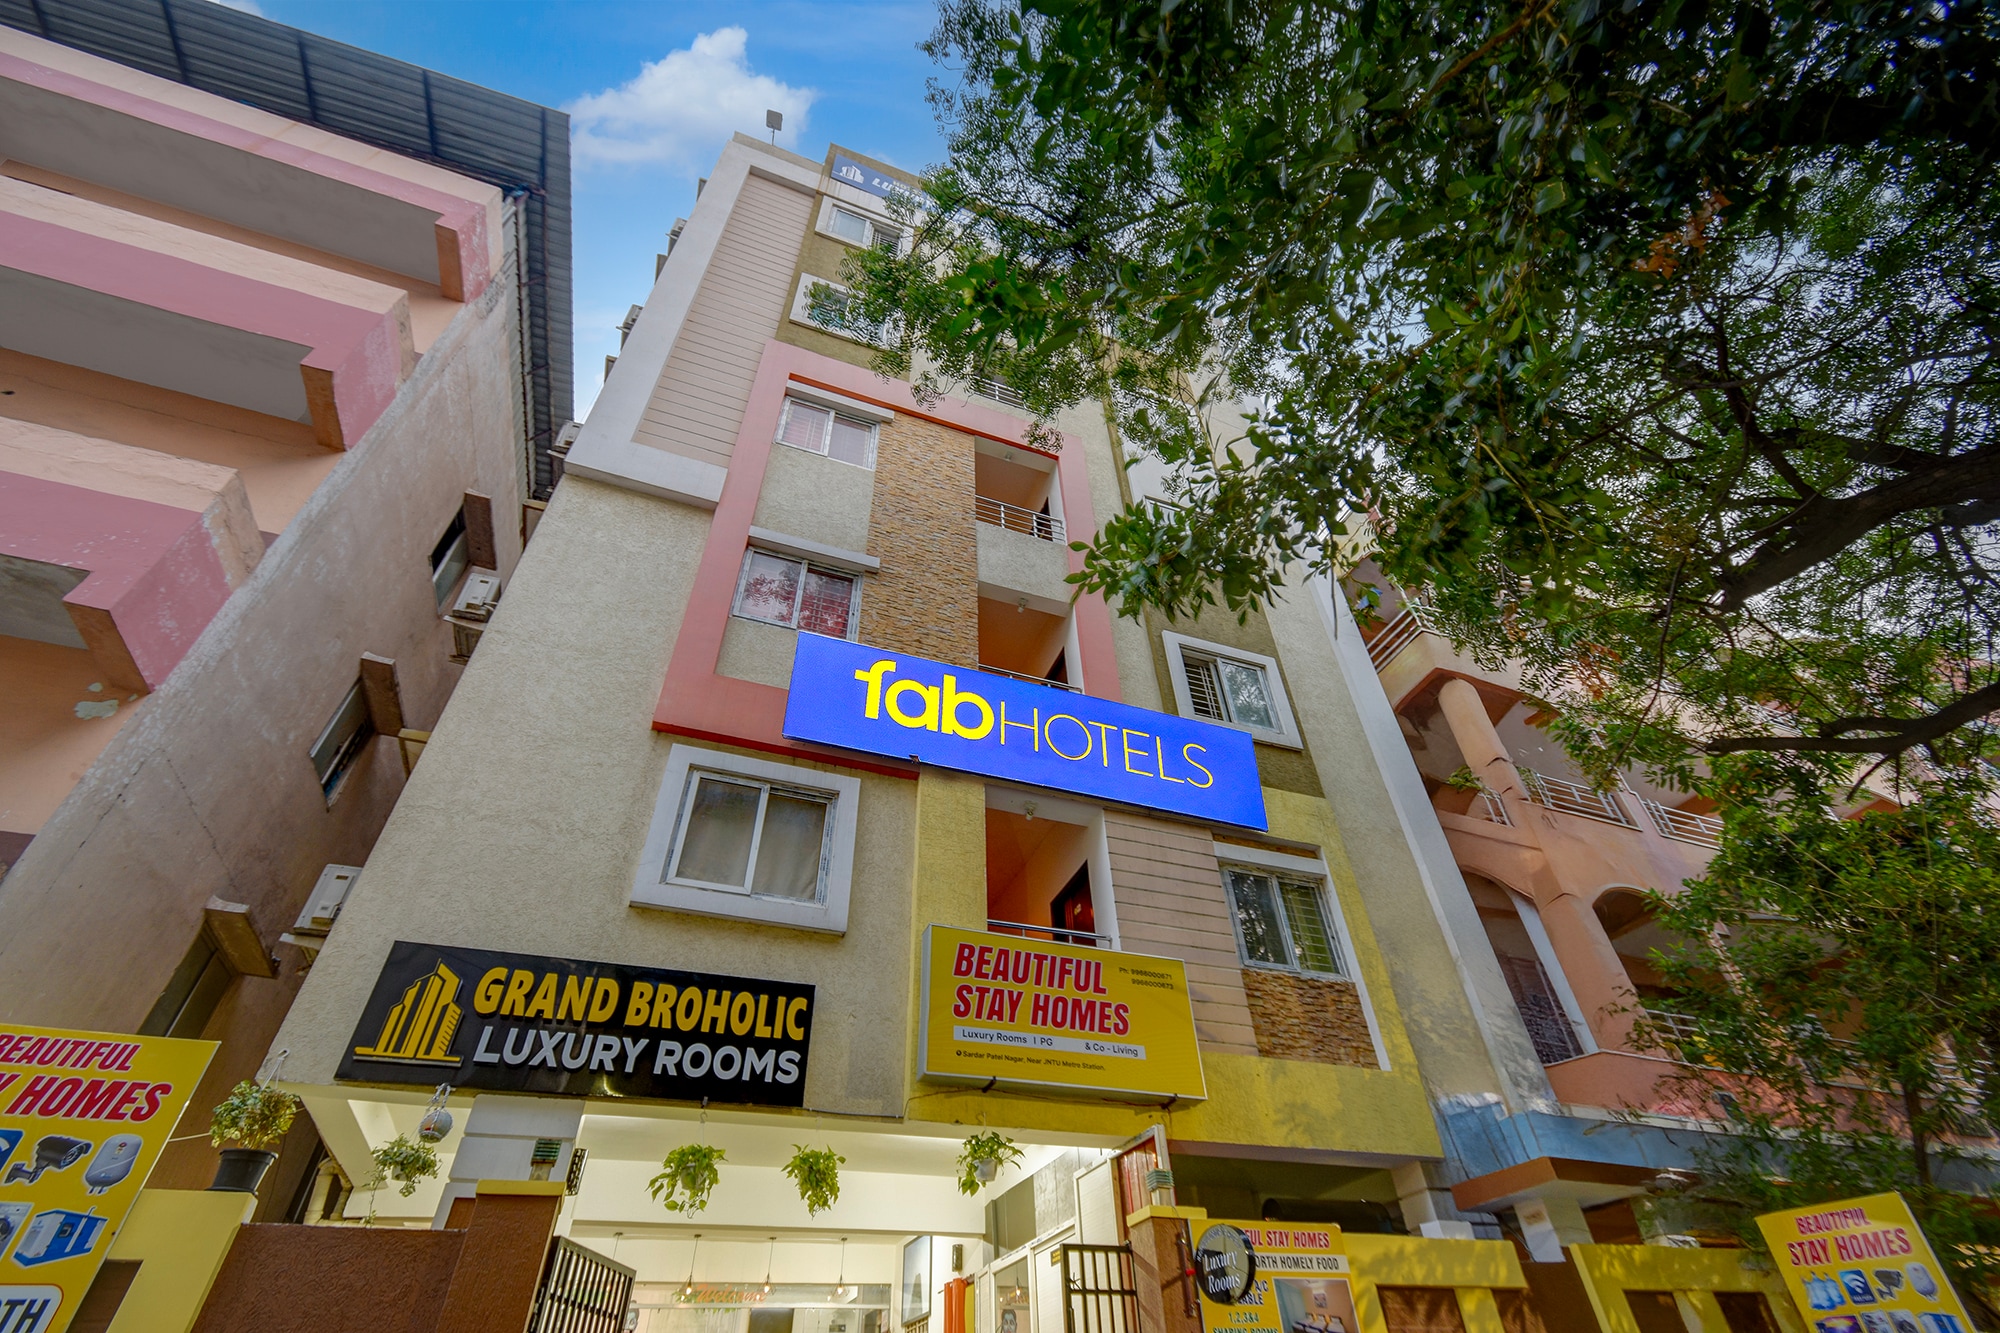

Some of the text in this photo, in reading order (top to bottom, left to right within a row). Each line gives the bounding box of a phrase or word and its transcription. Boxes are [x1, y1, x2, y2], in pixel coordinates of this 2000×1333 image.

[953, 942, 1107, 995] BEAUTIFUL
[472, 966, 808, 1041] GRAND BROHOLIC
[953, 984, 1130, 1036] STAY HOMES
[472, 1025, 801, 1085] LUXURY ROOMS
[962, 1029, 994, 1042] Luxury
[996, 1032, 1027, 1043] Rooms
[1040, 1037, 1053, 1046] PG
[1085, 1042, 1091, 1051] &
[1093, 1043, 1105, 1052] Co
[1112, 1045, 1138, 1058] Living
[963, 1050, 985, 1058] Sardar
[986, 1052, 1003, 1060] Patel
[1043, 1058, 1061, 1066] JNTU
[1062, 1061, 1081, 1069] Metro
[4, 1074, 173, 1123] HOMES
[1795, 1207, 1872, 1236] BEAUTIFUL
[1244, 1229, 1264, 1247] FUL
[1266, 1230, 1290, 1248] STAY
[1293, 1231, 1331, 1249] HOMES
[1787, 1227, 1912, 1267] STAY HOMES
[1204, 1251, 1237, 1271] Luxury
[1254, 1255, 1340, 1271] ORTH HOMELY FOOD
[1208, 1273, 1241, 1294] Rooms
[0, 1297, 51, 1333] TH
